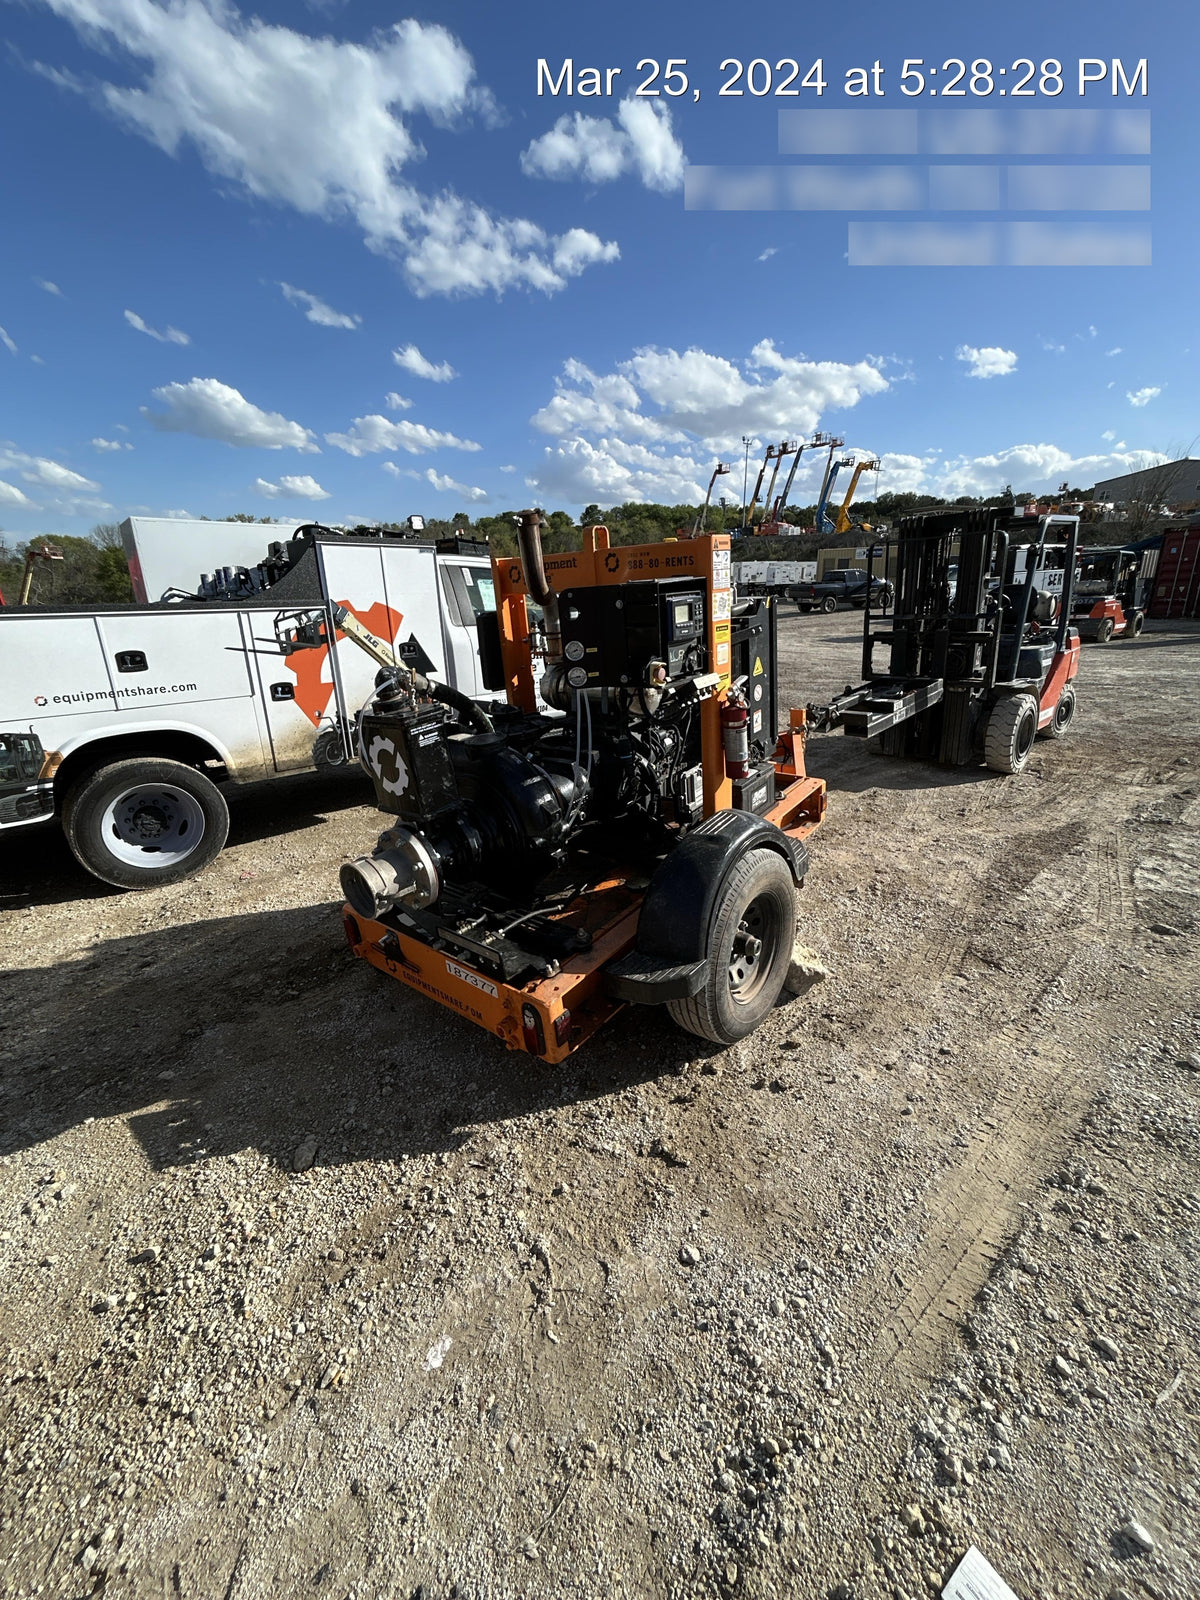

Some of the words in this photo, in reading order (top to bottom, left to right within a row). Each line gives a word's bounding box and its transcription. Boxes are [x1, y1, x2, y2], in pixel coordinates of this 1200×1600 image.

[363, 633, 379, 649] JLG
[52, 682, 198, 705] equipmentshare.com
[446, 961, 496, 995] 187377
